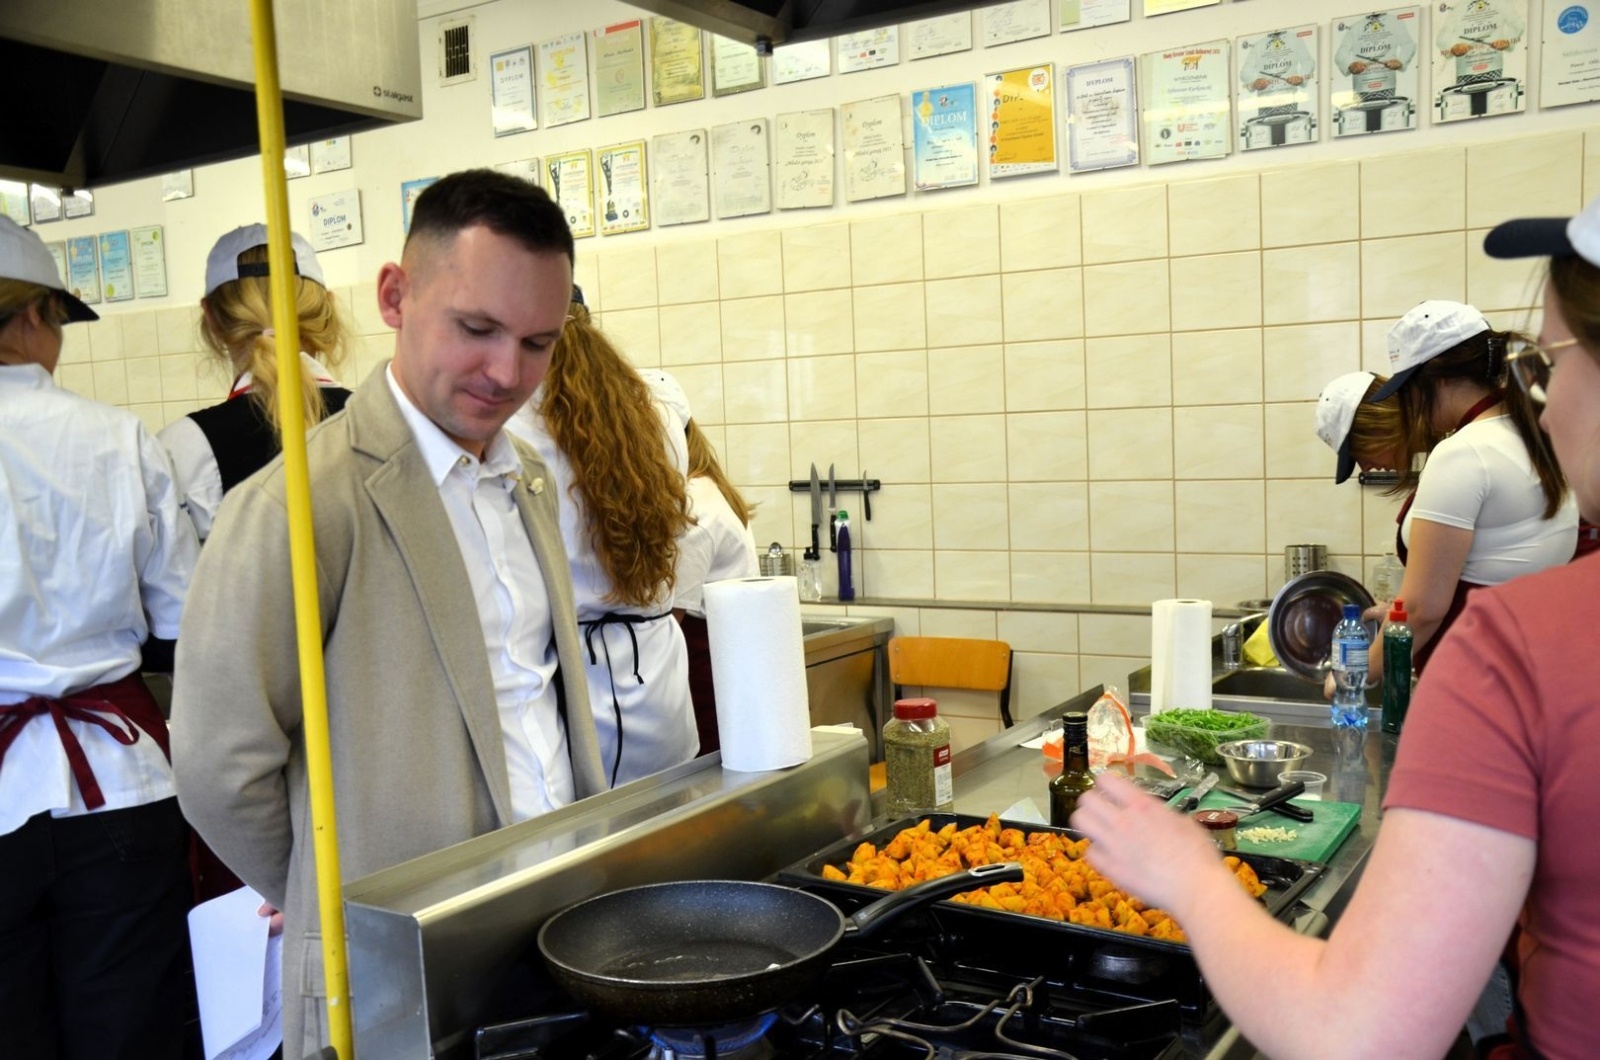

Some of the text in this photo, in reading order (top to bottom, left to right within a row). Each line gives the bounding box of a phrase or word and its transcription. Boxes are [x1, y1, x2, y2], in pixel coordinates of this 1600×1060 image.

[1464, 23, 1497, 35] DIPLOM
[1360, 43, 1391, 54] DIPLOM
[1263, 60, 1292, 70] DIPLOM
[500, 73, 524, 84] DYPLOM
[1086, 77, 1113, 87] DYPLOM
[383, 89, 413, 103] stalgast
[323, 214, 346, 226] DIPLOM
